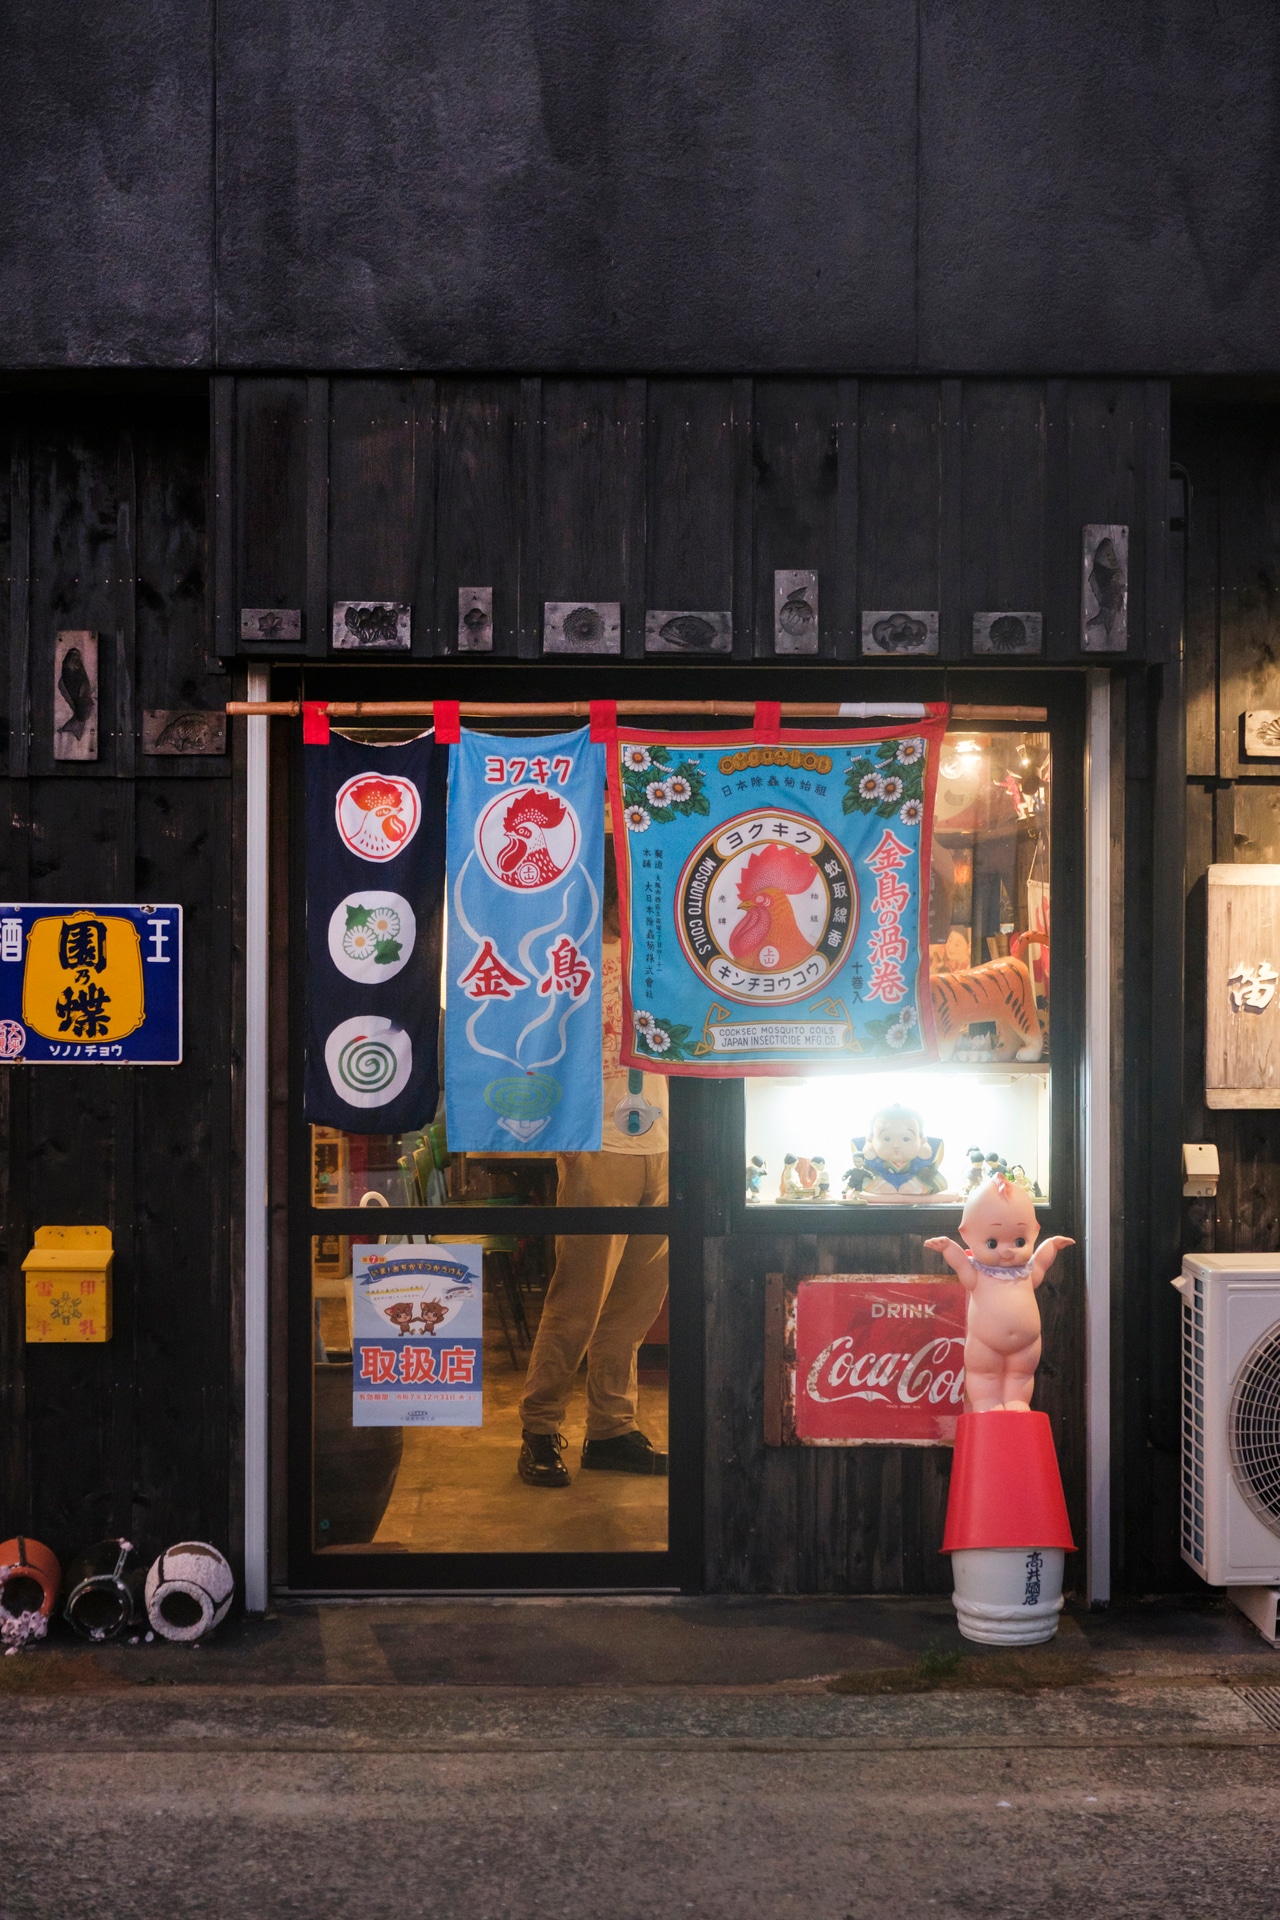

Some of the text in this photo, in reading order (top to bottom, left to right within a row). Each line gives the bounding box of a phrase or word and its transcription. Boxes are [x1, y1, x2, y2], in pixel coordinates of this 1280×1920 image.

[486, 757, 572, 785] ヨクキク
[726, 822, 812, 850] ヨクキク
[688, 857, 717, 955] MOSQUITO COILS
[824, 859, 848, 948] 蚊取線香
[864, 829, 914, 1004] 金鳥の渦巻
[147, 919, 171, 962] 王
[458, 934, 594, 1001] 金鳥
[49, 1045, 123, 1057] ソノノチョウ
[719, 1026, 834, 1037] COCKSEC MOSQUITO COILS
[721, 1037, 749, 1048] JAPAN
[750, 1035, 801, 1046] INSECTICIDE
[871, 1303, 937, 1319] DRINK
[360, 1345, 476, 1384] 取扱店
[806, 1336, 965, 1404] Coca-Col
